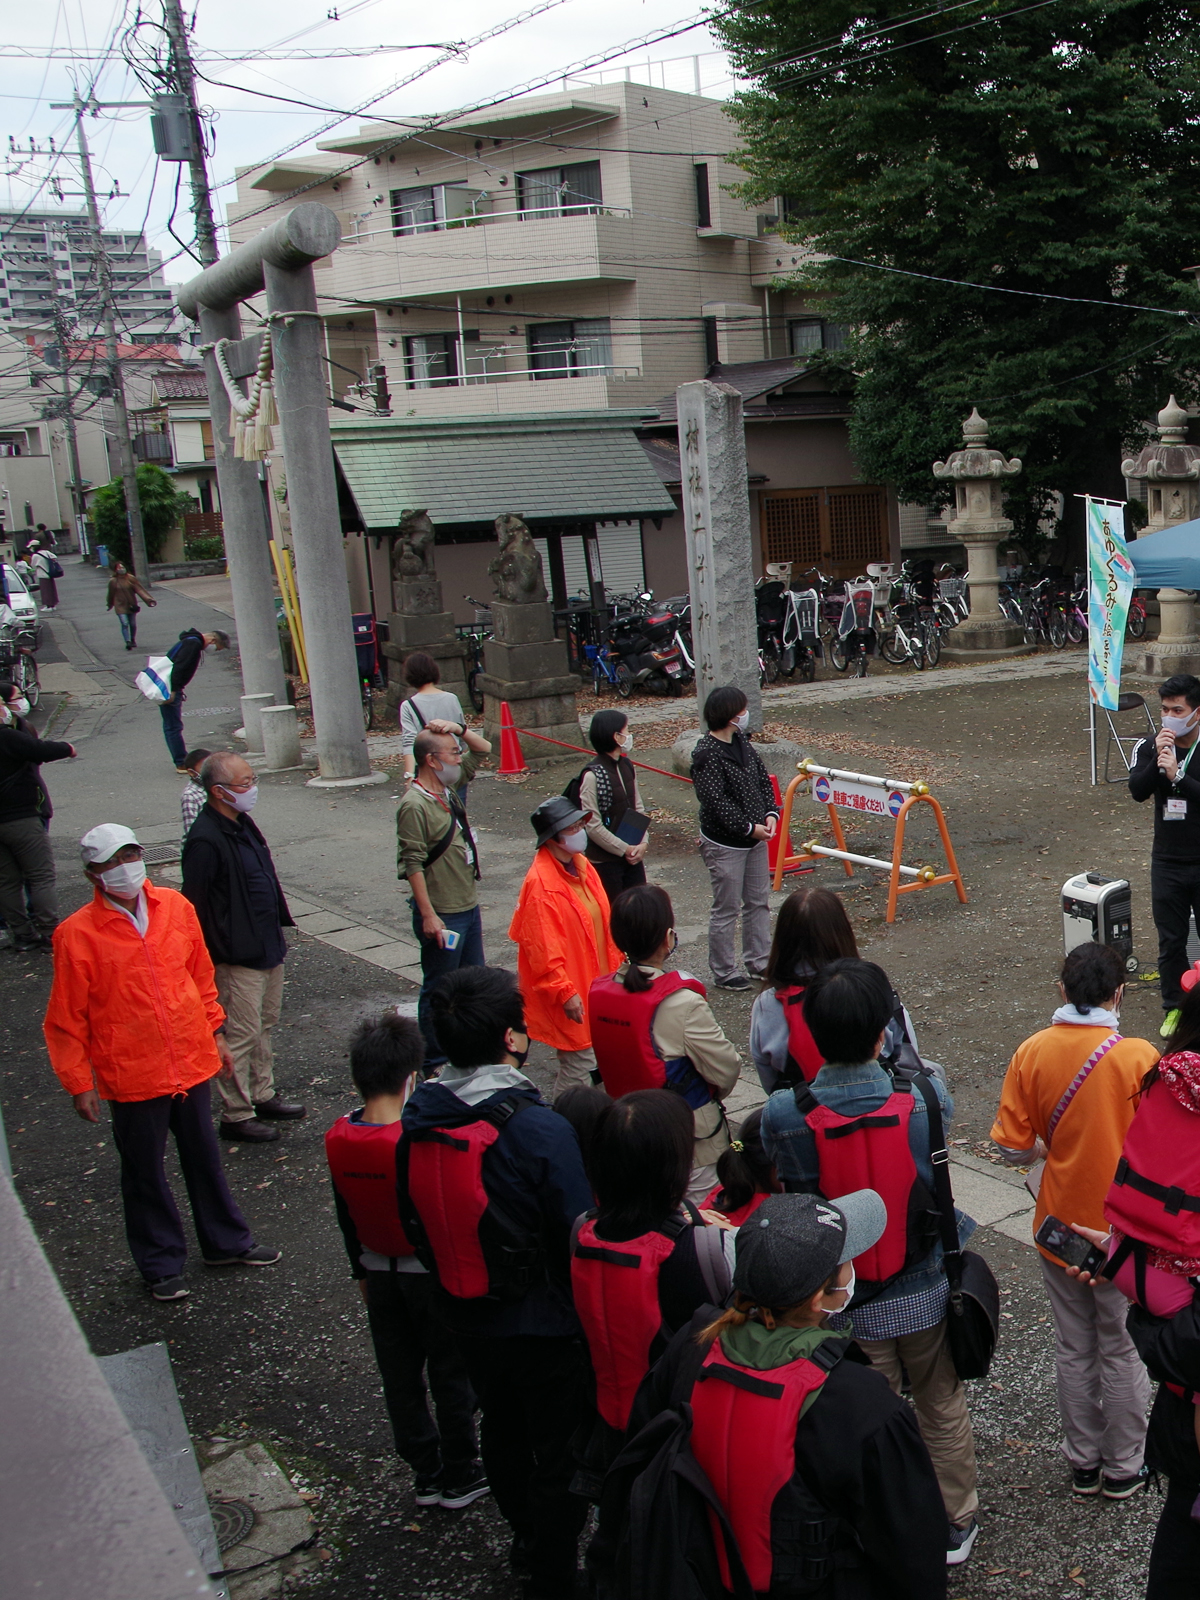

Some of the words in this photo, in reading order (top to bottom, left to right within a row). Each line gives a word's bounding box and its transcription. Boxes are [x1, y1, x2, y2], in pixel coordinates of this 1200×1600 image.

[833, 790, 885, 812] 駐車ご遠慮ください
[815, 1203, 843, 1232] N
